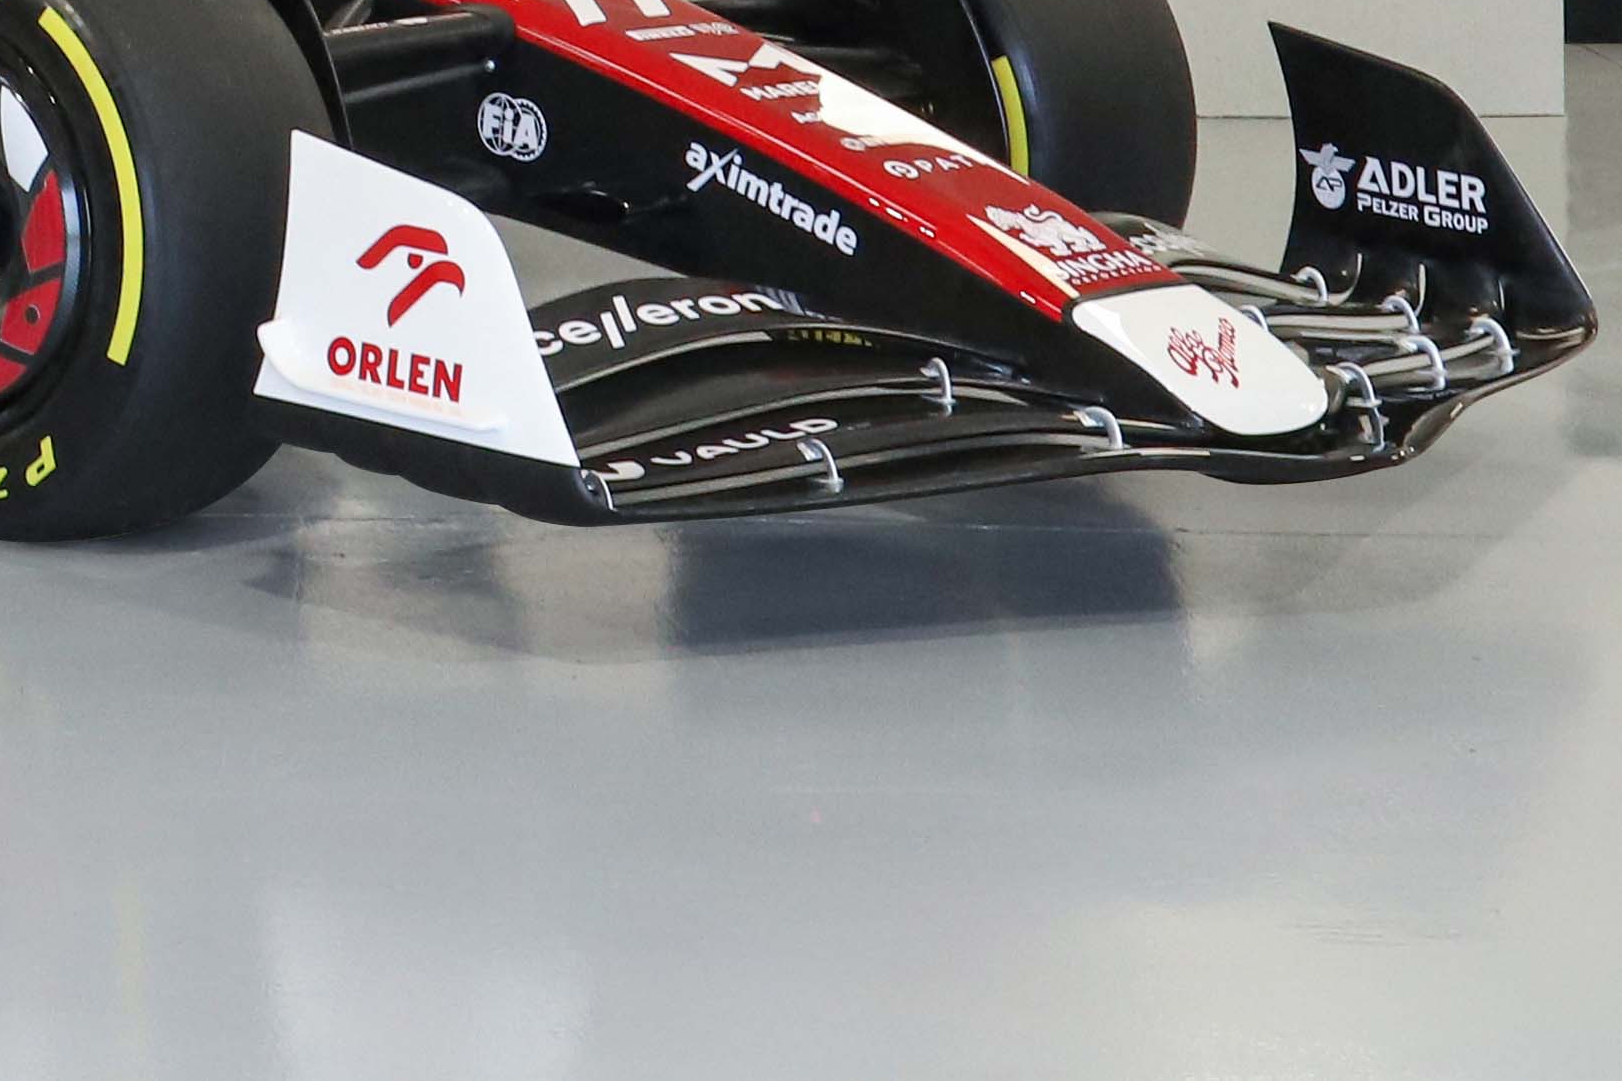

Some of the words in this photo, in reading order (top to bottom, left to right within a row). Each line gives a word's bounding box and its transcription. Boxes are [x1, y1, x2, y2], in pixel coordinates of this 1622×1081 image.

[914, 154, 975, 173] PAT
[1356, 156, 1487, 214] ADLER
[684, 140, 859, 257] aximtrade
[532, 291, 784, 356] celleron
[327, 335, 463, 403] ORLEN
[25, 435, 58, 488] P
